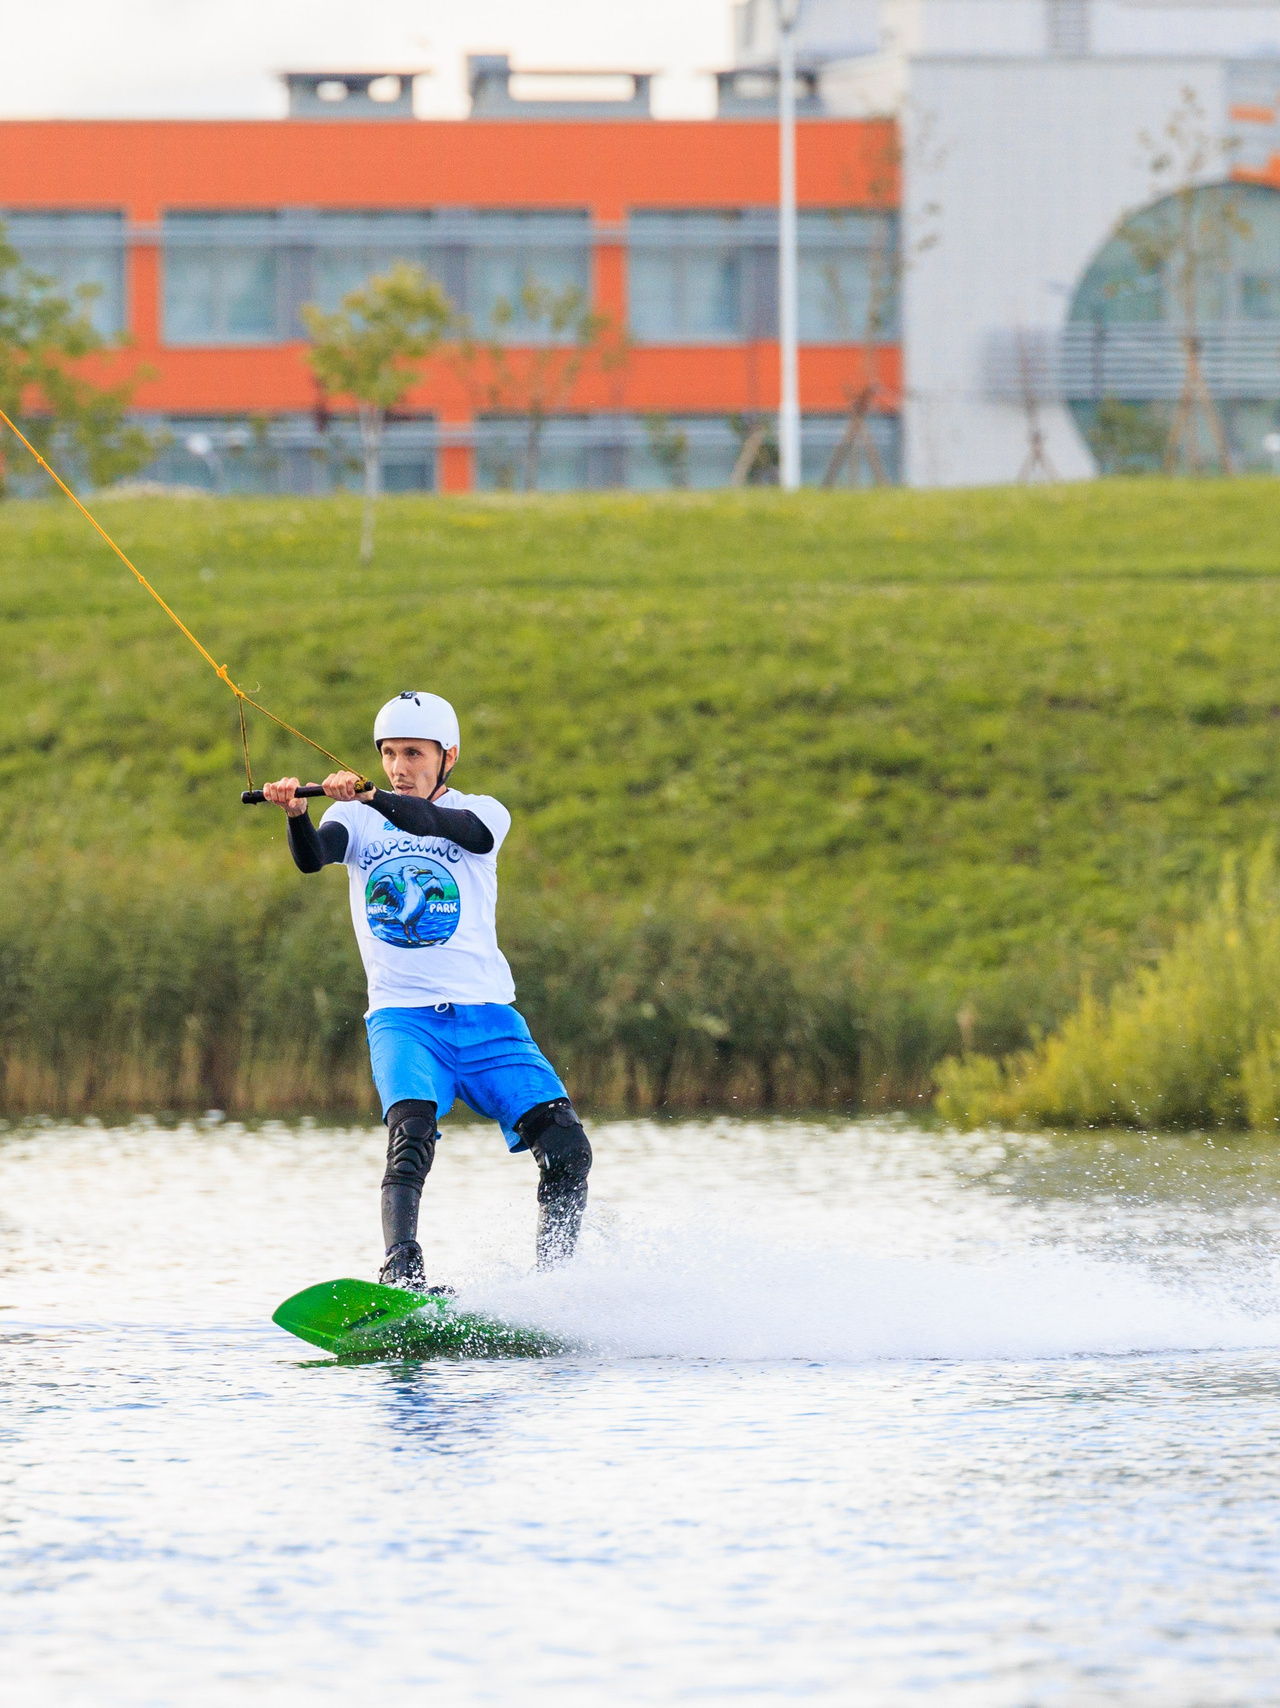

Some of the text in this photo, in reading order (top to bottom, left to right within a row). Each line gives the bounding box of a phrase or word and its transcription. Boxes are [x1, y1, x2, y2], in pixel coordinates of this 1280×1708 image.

[358, 836, 463, 870] KUPCHINO
[367, 902, 458, 915] WAKE PARK
